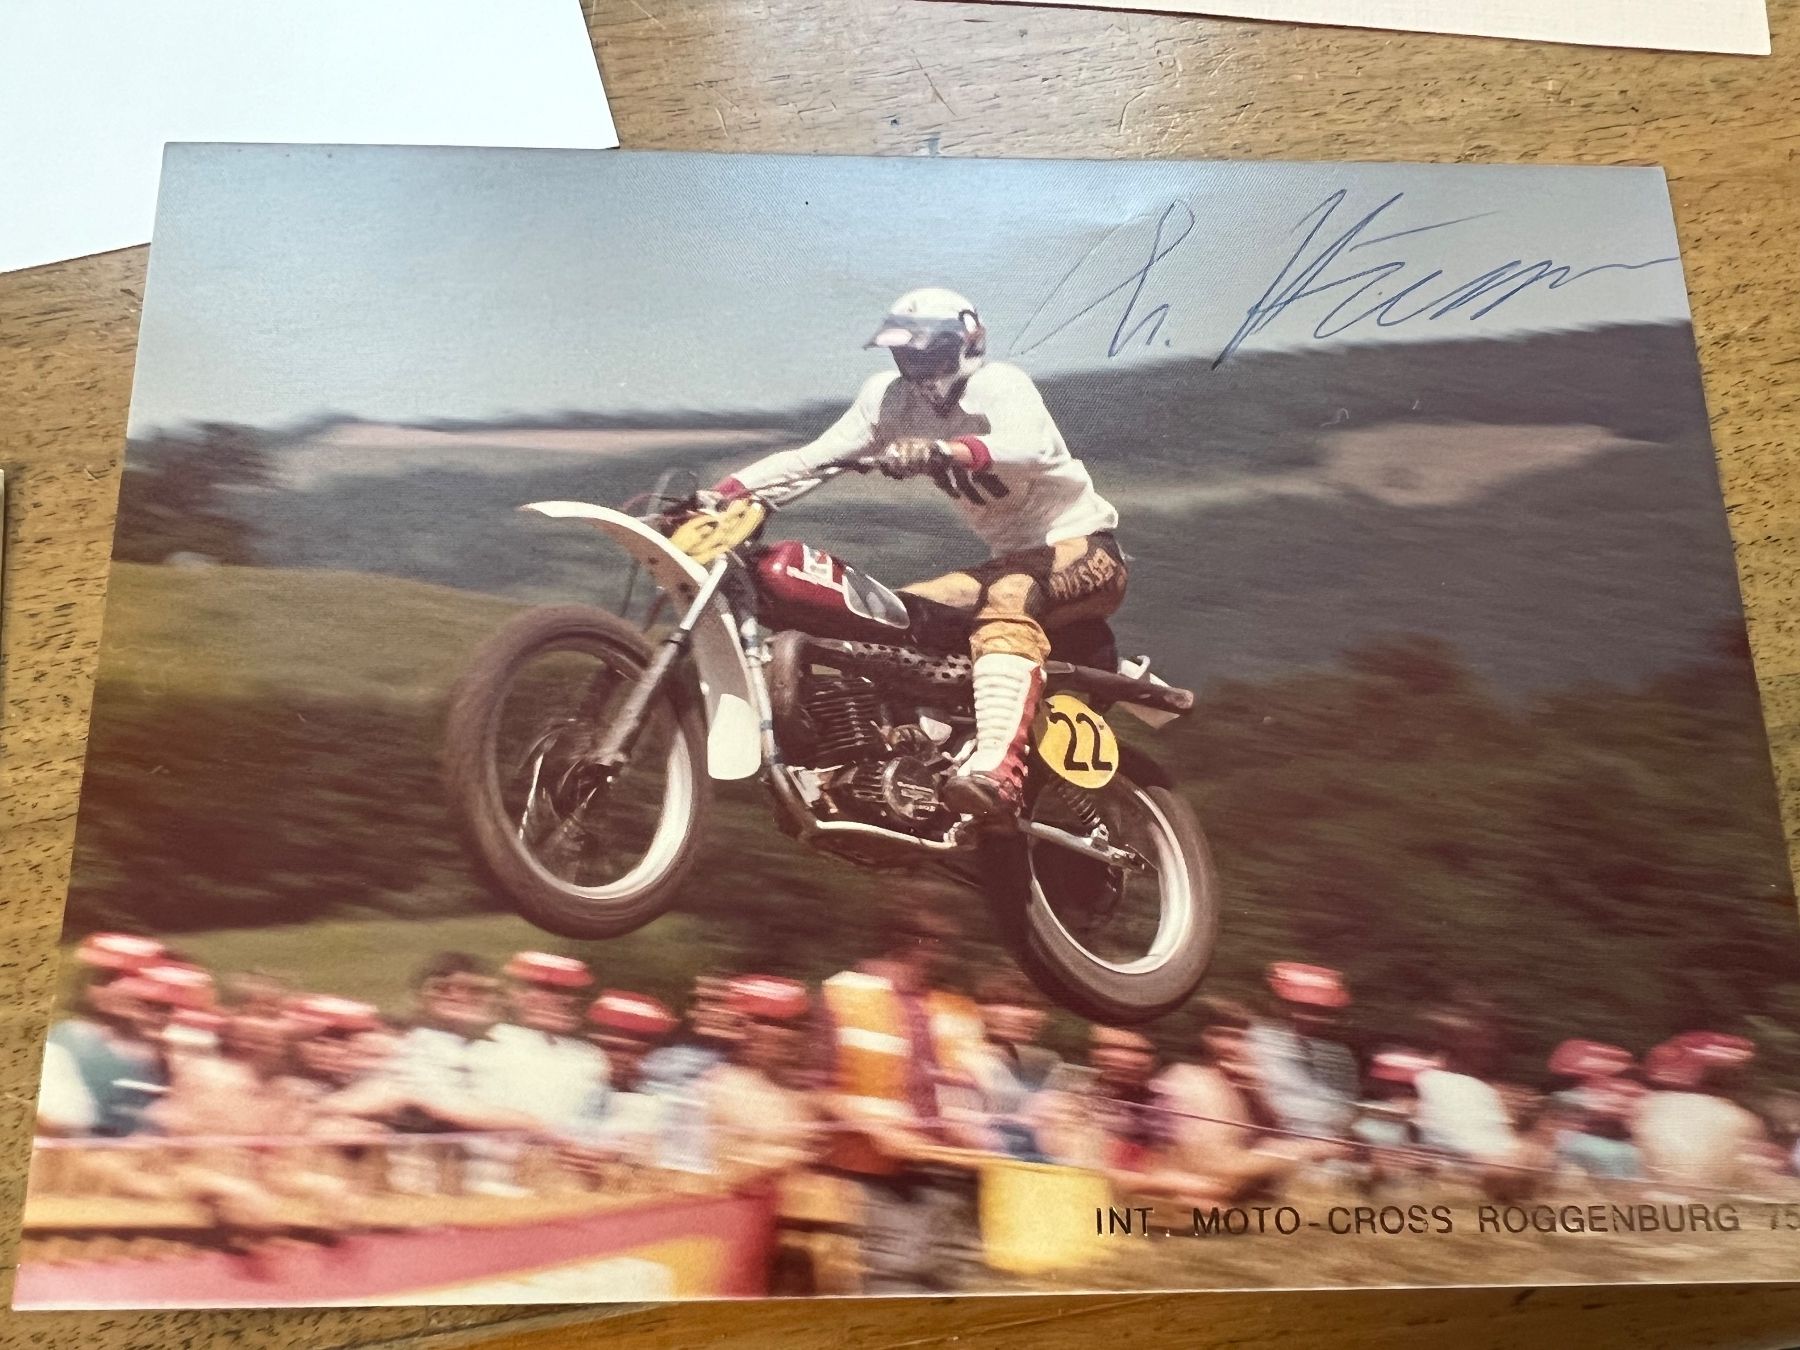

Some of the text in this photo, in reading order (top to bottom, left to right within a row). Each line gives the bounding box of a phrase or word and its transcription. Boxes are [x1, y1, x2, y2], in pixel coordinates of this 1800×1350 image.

[1050, 711, 1113, 771] 22
[1096, 1206, 1170, 1237] INT.
[1192, 1204, 1453, 1235] MOTO-CROSS
[1478, 1204, 1741, 1234] ROGGENBURG
